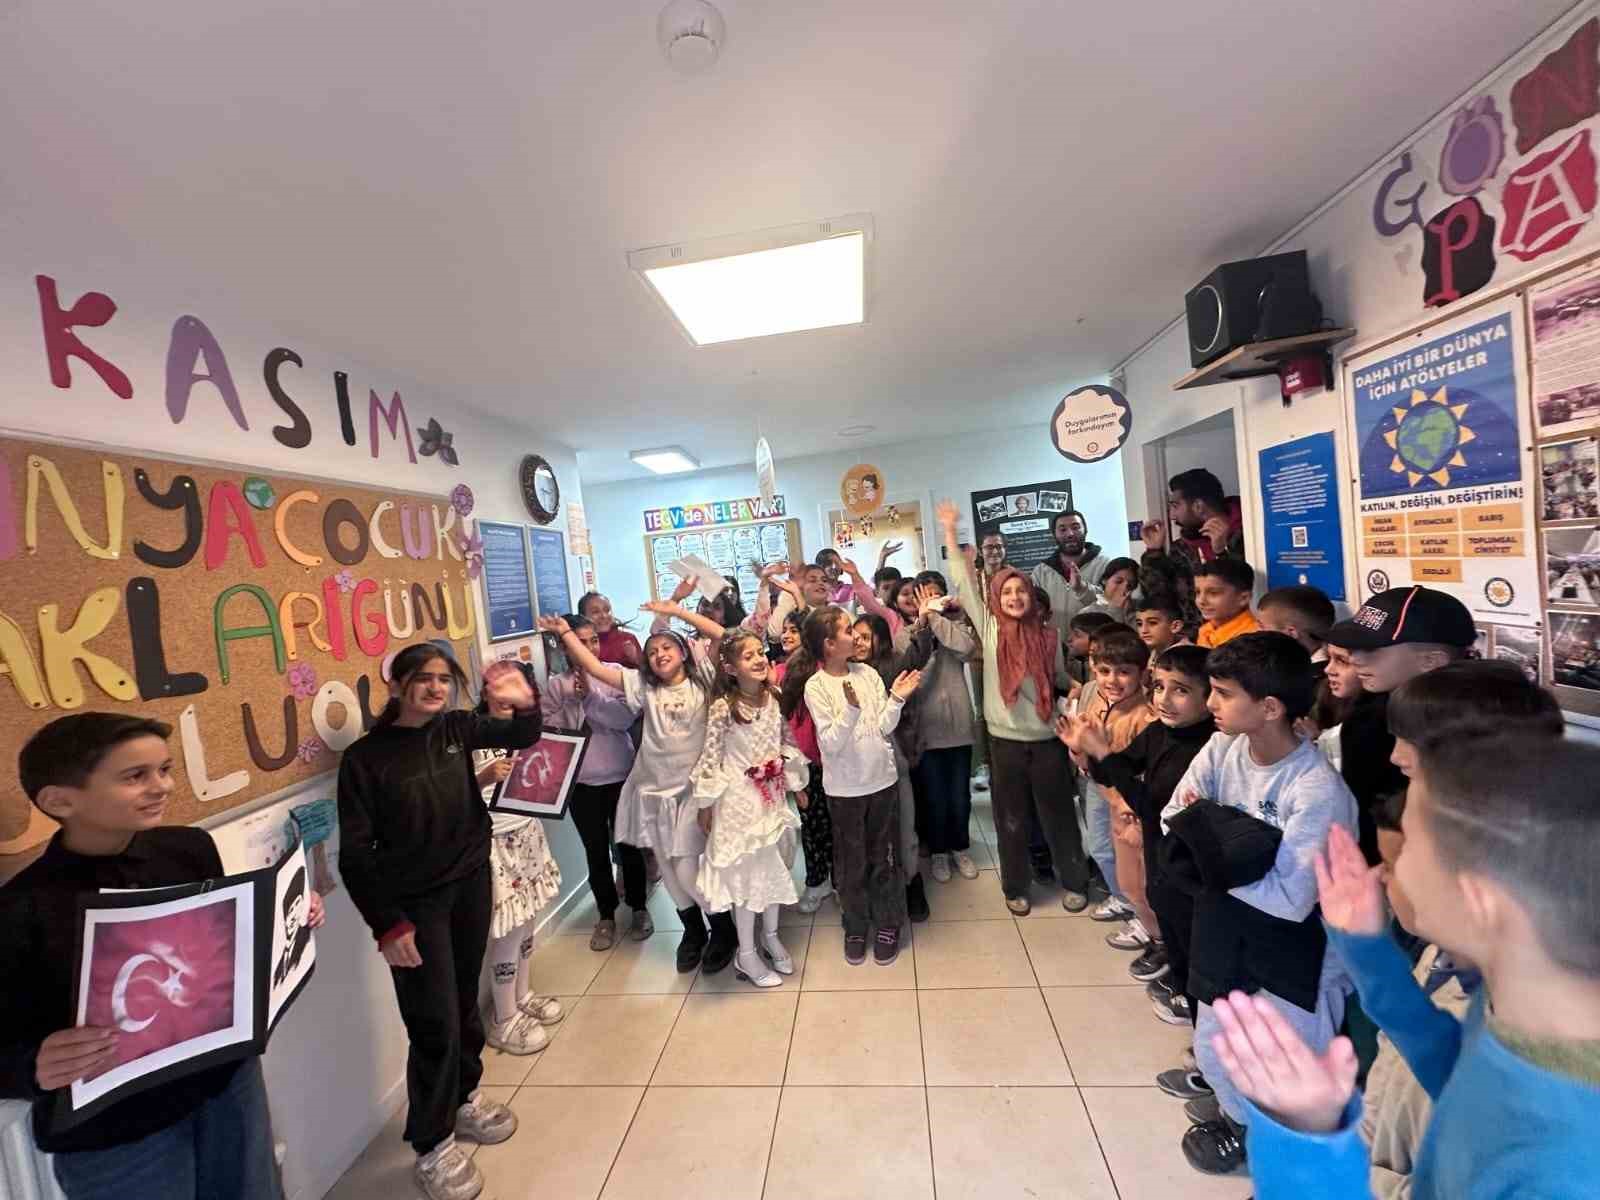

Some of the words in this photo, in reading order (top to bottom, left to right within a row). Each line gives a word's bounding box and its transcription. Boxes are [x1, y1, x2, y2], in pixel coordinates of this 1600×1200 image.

[36, 275, 417, 464] KASIM
[1355, 366, 1391, 389] DAHA
[1393, 355, 1411, 376] İYİ
[1413, 348, 1441, 368] BİR
[1443, 324, 1507, 357] DÜNYA
[1369, 381, 1396, 400] İÇİN
[1400, 351, 1488, 391] ATÖLYELER
[1447, 487, 1524, 504] DEĞİŞTİRİN!
[351, 568, 476, 657] GÜNÜ
